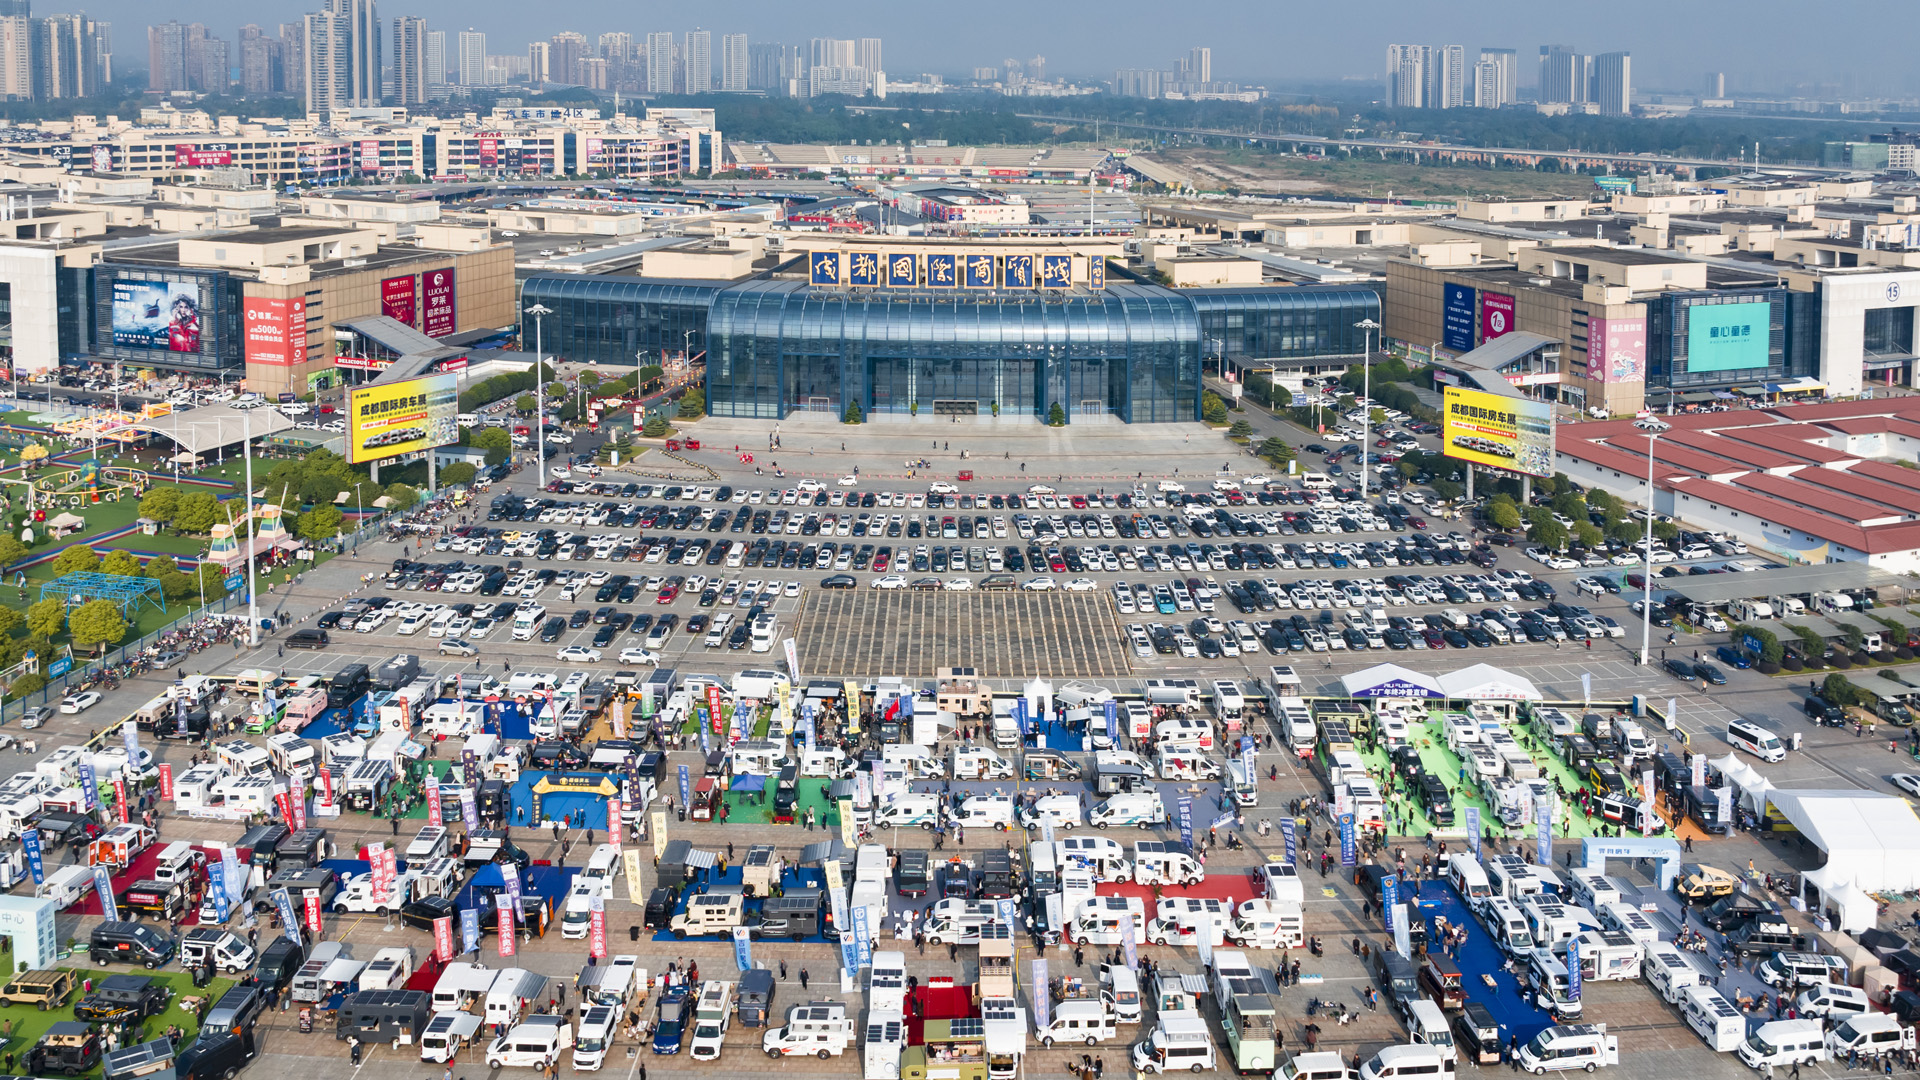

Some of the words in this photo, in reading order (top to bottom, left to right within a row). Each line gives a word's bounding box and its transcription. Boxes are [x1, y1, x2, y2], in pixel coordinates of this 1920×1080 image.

[428, 286, 450, 296] LUOLAI
[1887, 286, 1898, 298] 15
[431, 295, 446, 307] 罗莱
[360, 393, 427, 416] 成都国际房车展
[1451, 403, 1517, 425] 成都国际房车展
[1369, 688, 1428, 697] 工厂年终冲量直销
